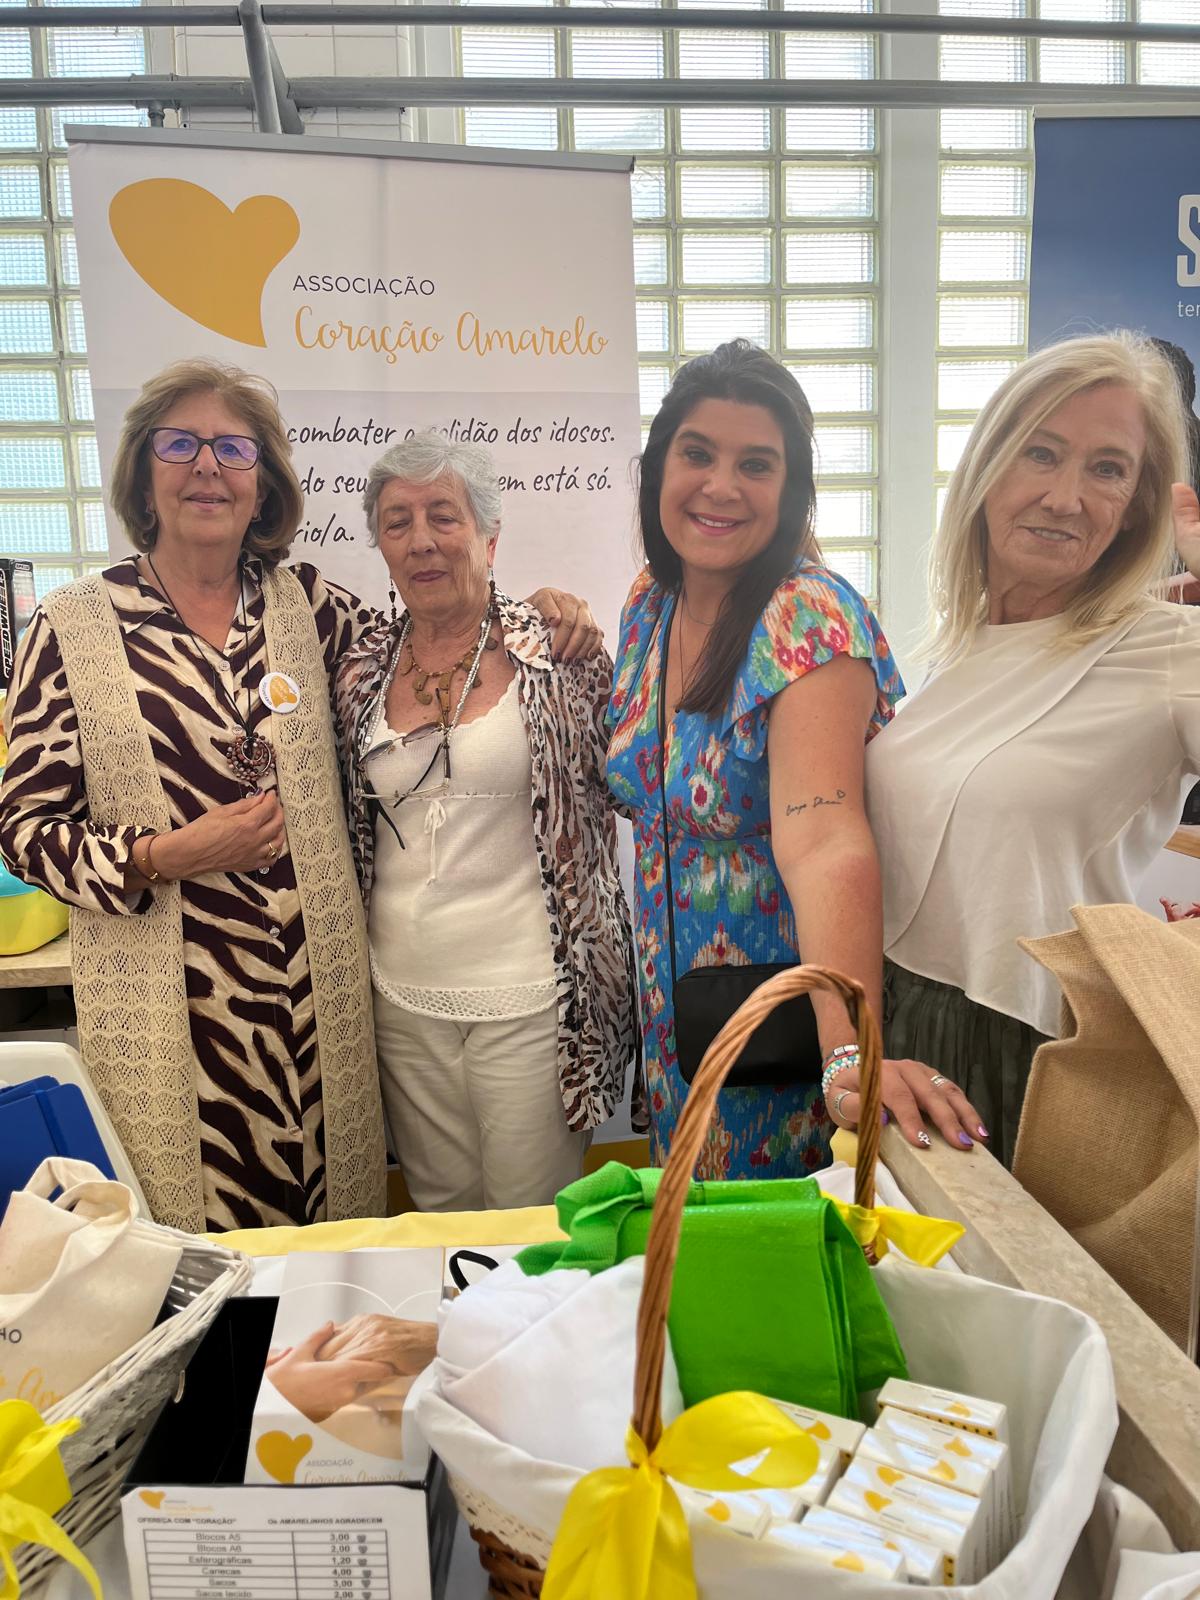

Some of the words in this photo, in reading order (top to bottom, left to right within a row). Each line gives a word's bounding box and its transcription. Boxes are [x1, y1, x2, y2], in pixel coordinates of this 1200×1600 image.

[293, 274, 435, 298] ASSOCIAÇÃO
[295, 305, 444, 364] Coração
[457, 311, 609, 356] Amarelo
[287, 416, 397, 446] combater
[507, 417, 542, 444] dos
[549, 417, 615, 443] idosos.
[533, 466, 580, 493] está
[586, 466, 611, 491] só.
[306, 1457, 354, 1467] ASSOCIAÇÃO
[196, 1533, 226, 1541] Blocos
[197, 1545, 227, 1553] Blocos
[331, 1545, 351, 1555] 2,00
[202, 1567, 241, 1575] Canecas
[332, 1568, 352, 1578] 4,00
[209, 1578, 236, 1586] Sacos
[333, 1580, 353, 1589] 3,00
[196, 1590, 223, 1598] Sacos
[334, 1591, 354, 1600] 2,00
